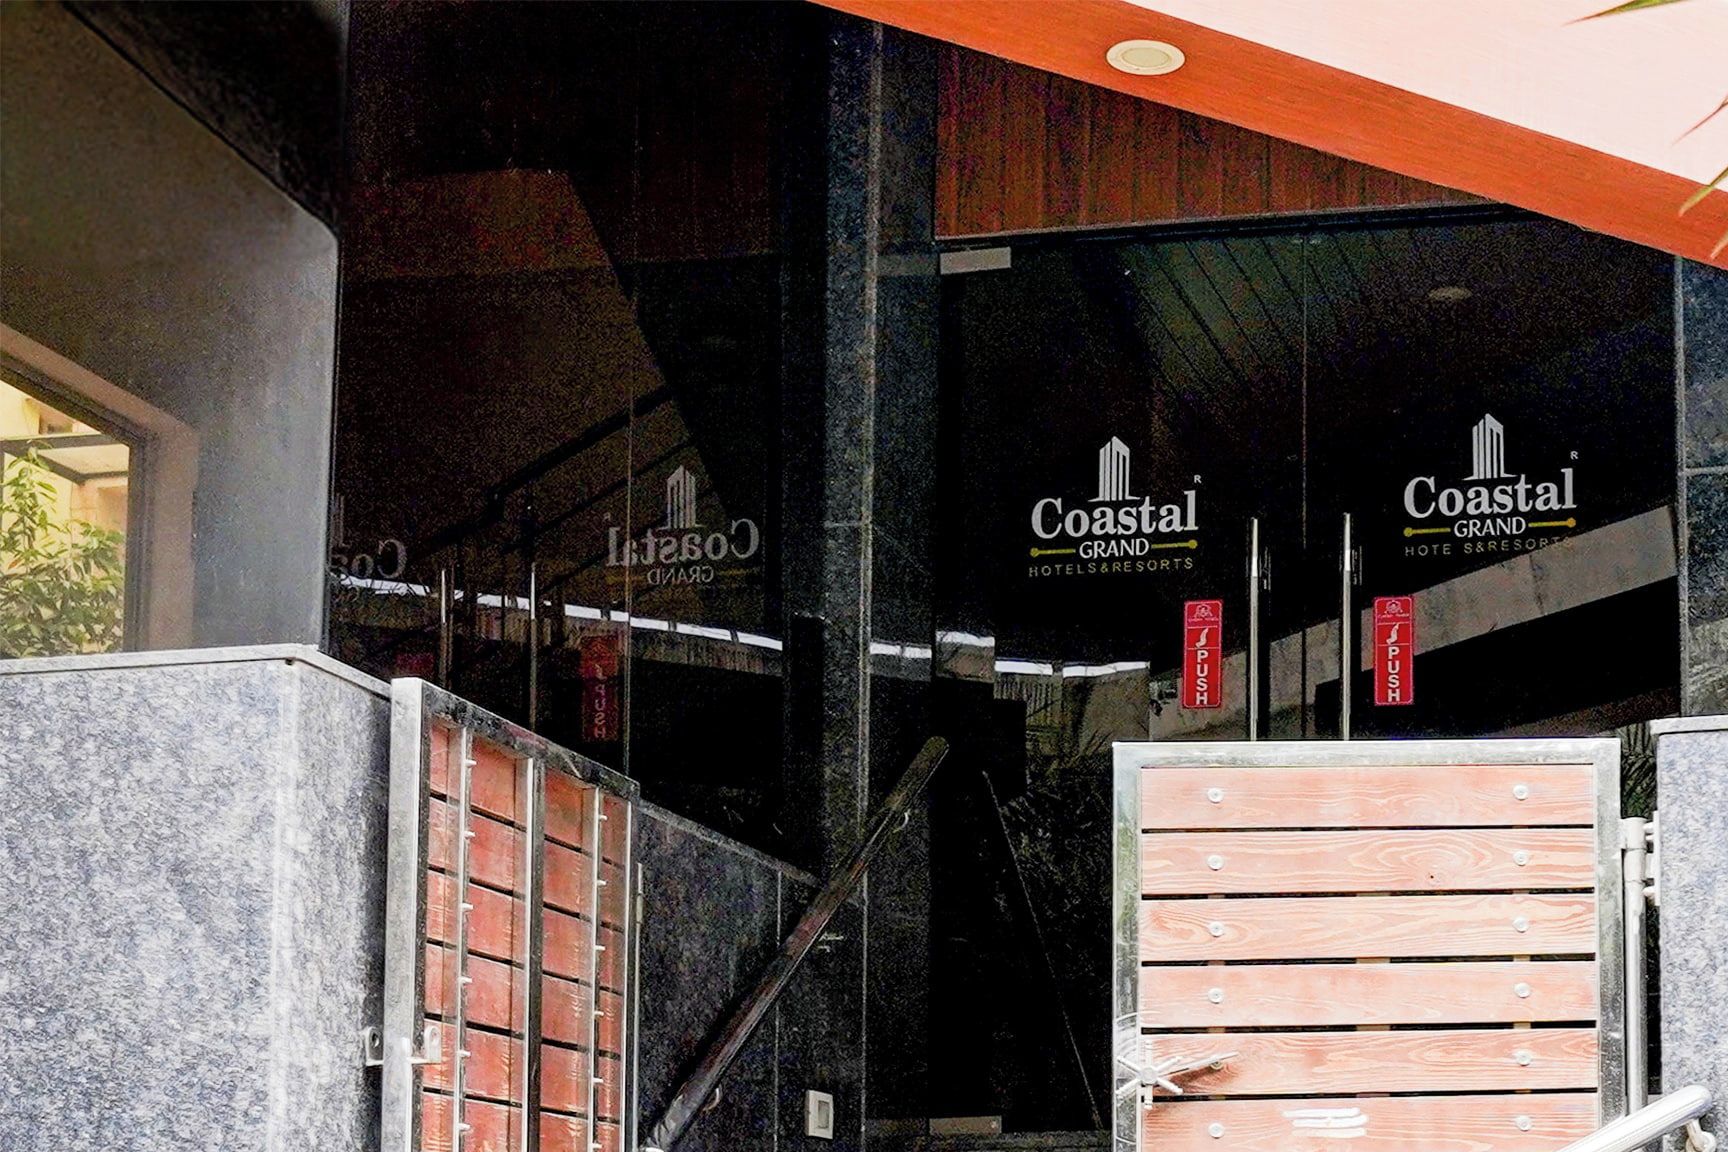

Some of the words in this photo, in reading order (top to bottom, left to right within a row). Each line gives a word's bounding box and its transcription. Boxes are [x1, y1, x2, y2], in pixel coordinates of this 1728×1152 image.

[1031, 490, 1199, 539] Coastal
[1404, 468, 1577, 518] Coastal
[1079, 538, 1149, 559] GRAND
[1454, 517, 1526, 538] GRAND
[1196, 650, 1208, 705] PUSH
[1387, 647, 1400, 702] PUSH
